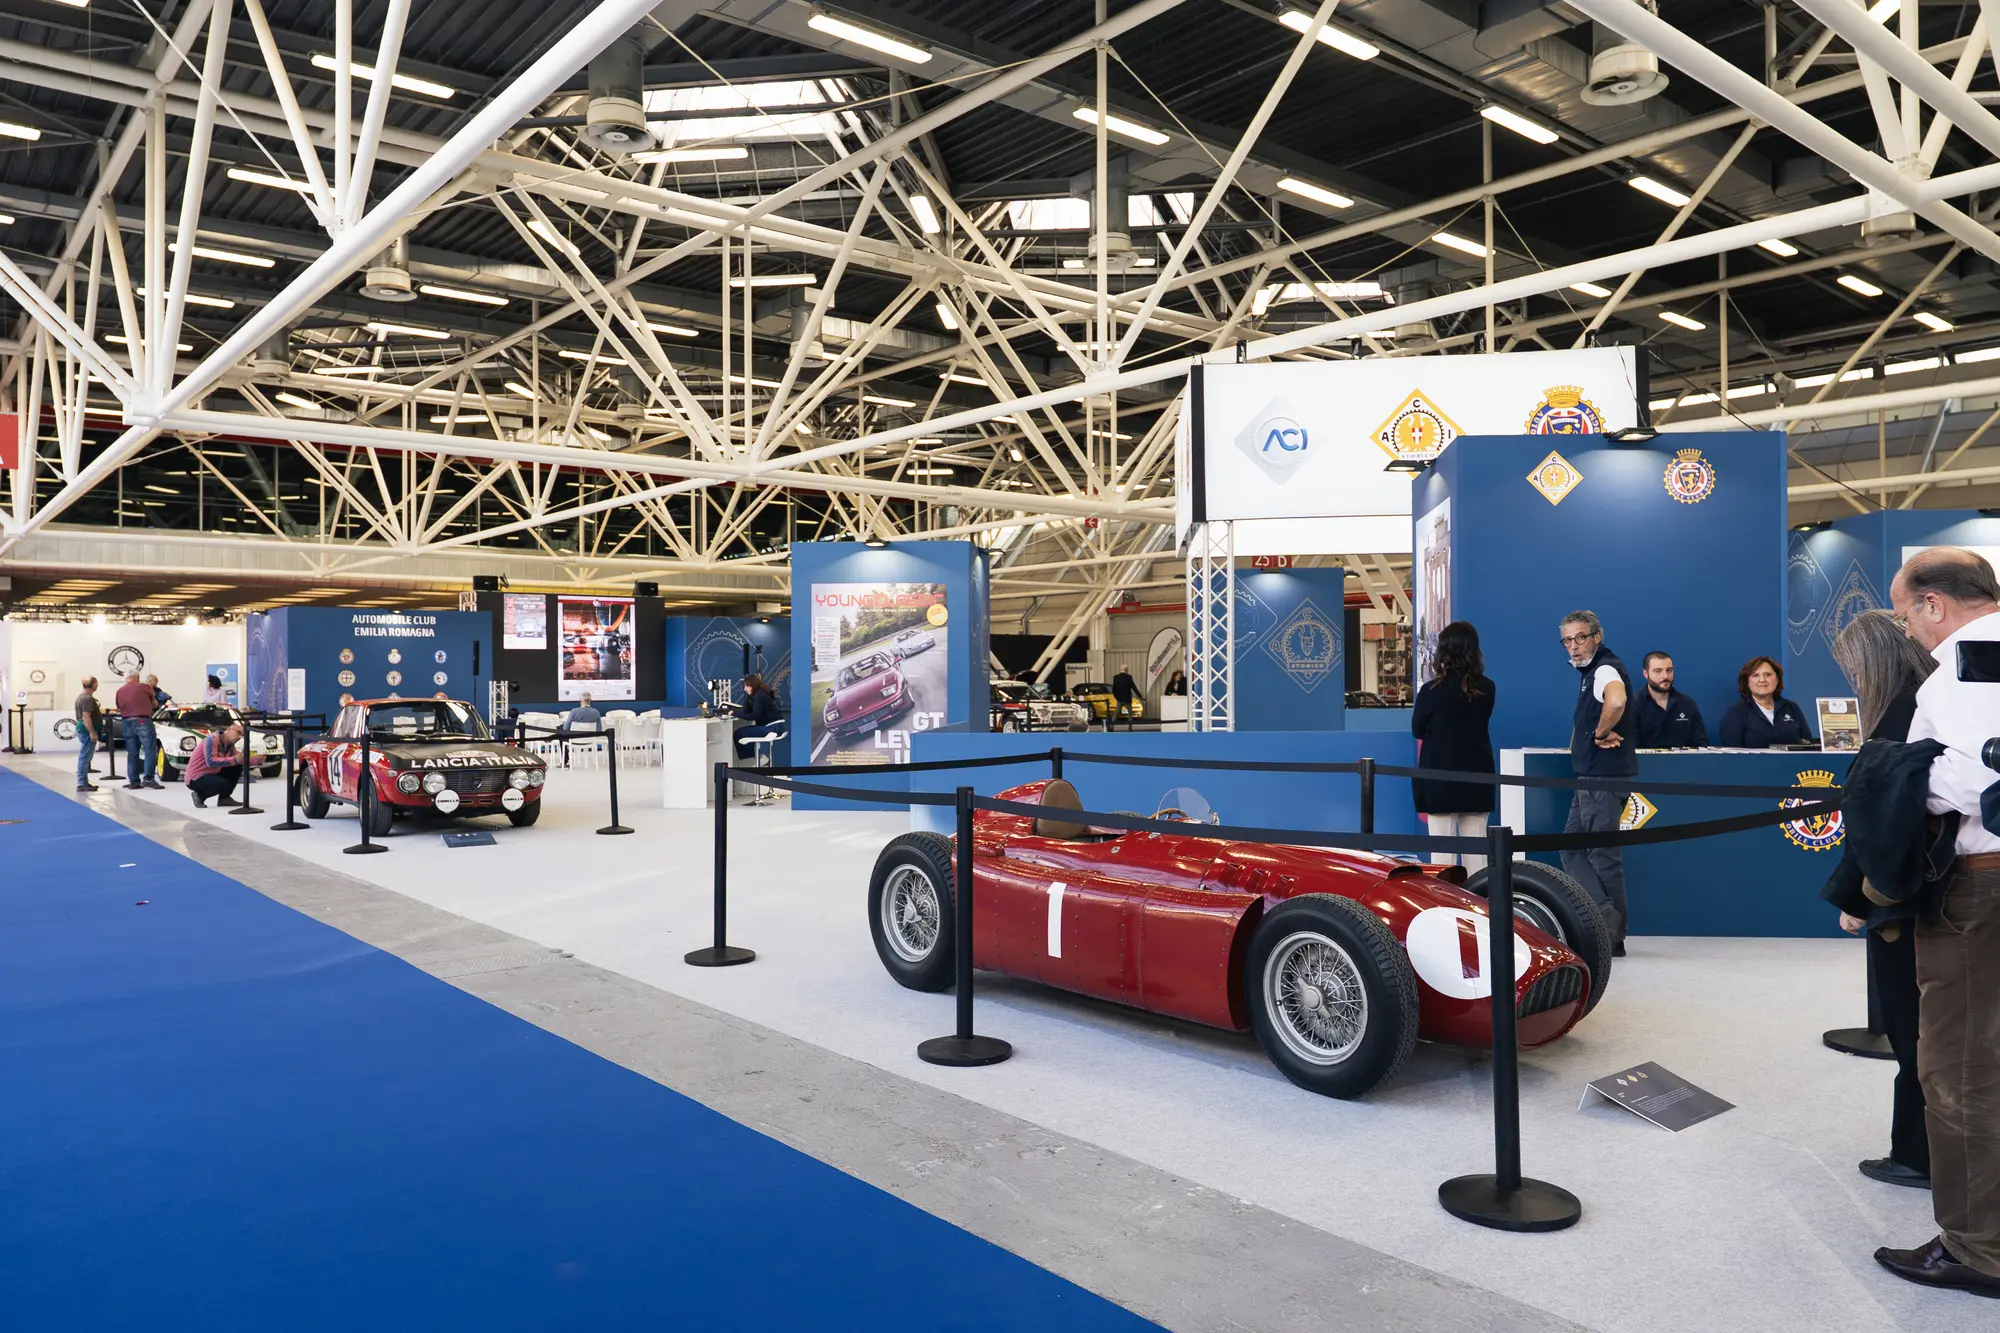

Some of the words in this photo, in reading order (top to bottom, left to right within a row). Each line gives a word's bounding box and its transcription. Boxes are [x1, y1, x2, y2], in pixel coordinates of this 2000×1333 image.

[1412, 399, 1421, 408] C
[1263, 428, 1309, 451] ACI
[1381, 431, 1390, 443] A
[1255, 555, 1270, 567] 25
[352, 615, 412, 625] AUTOMOBILE
[413, 615, 437, 625] CLUB
[354, 627, 387, 637] EMILIA
[388, 627, 435, 637] ROMAGNA
[1290, 662, 1326, 670] STORICO
[912, 711, 945, 732] GT
[328, 748, 345, 786] 14
[411, 755, 539, 769] LANCIA-ITALIA
[1812, 834, 1839, 847] CLUB
[1046, 881, 1068, 959] 1
